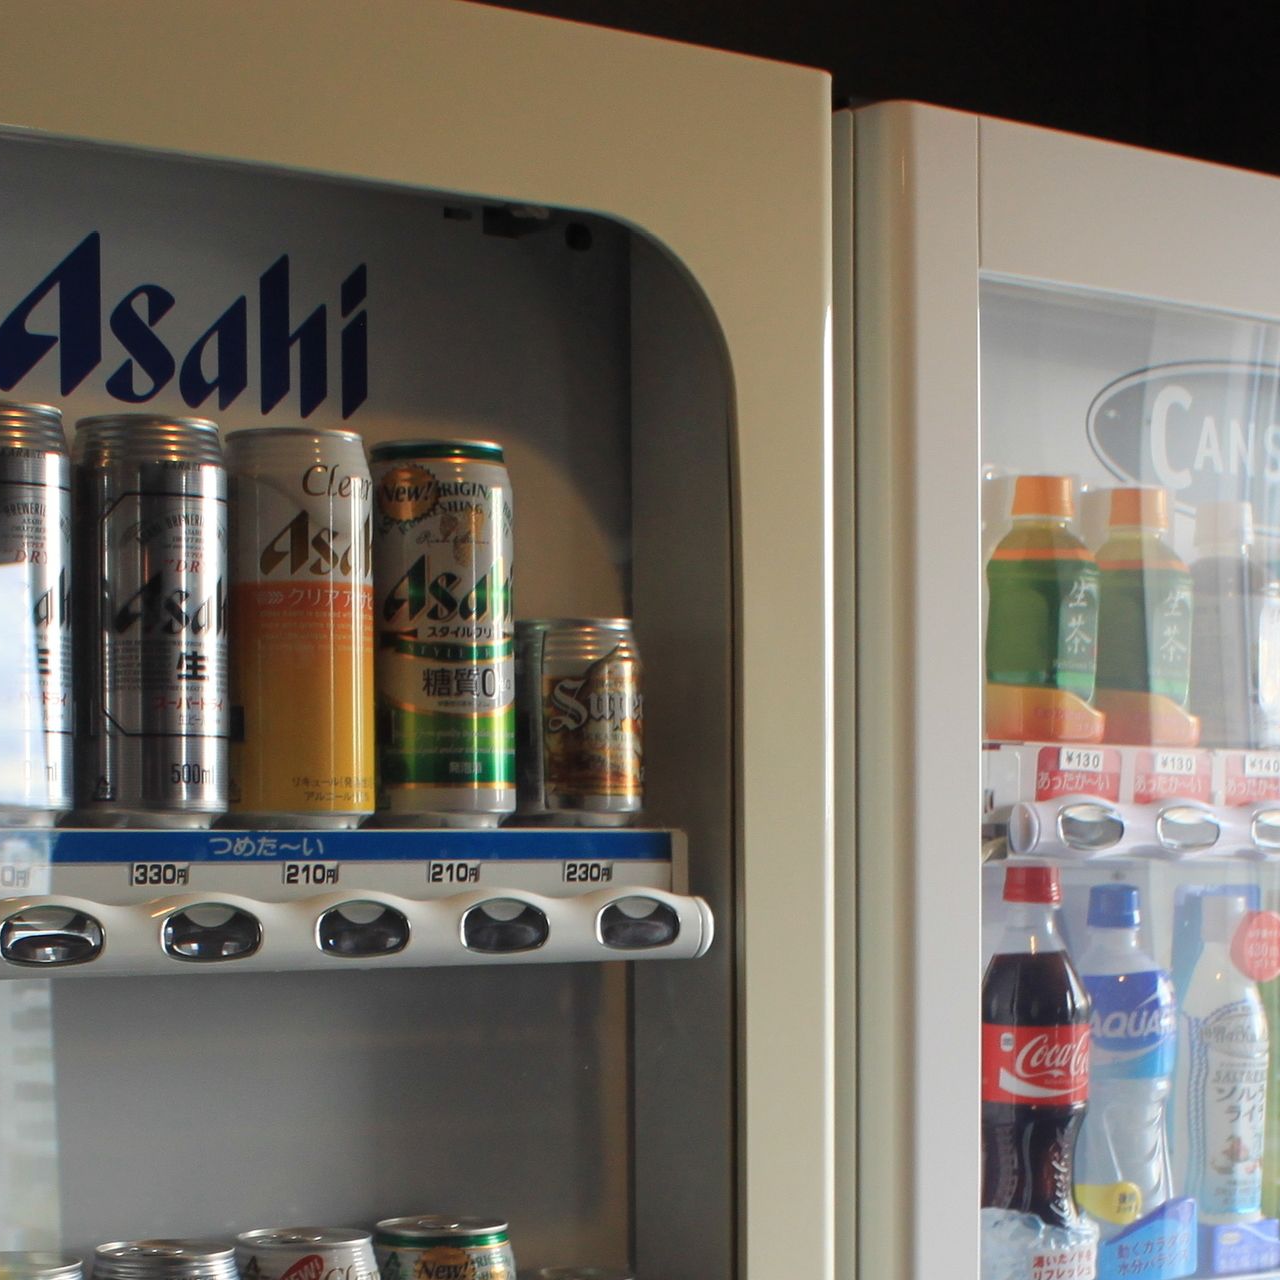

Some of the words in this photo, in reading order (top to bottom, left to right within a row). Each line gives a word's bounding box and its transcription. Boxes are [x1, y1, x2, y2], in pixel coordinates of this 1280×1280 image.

[176, 650, 209, 681] 生
[1066, 751, 1101, 769] ¥130
[1160, 754, 1193, 771] ¥130
[1249, 759, 1280, 773] ¥140
[170, 763, 216, 786] 500ml
[133, 863, 188, 886] 330円
[286, 864, 337, 885] 210円
[431, 863, 479, 883] 210円
[566, 863, 611, 882] 230円
